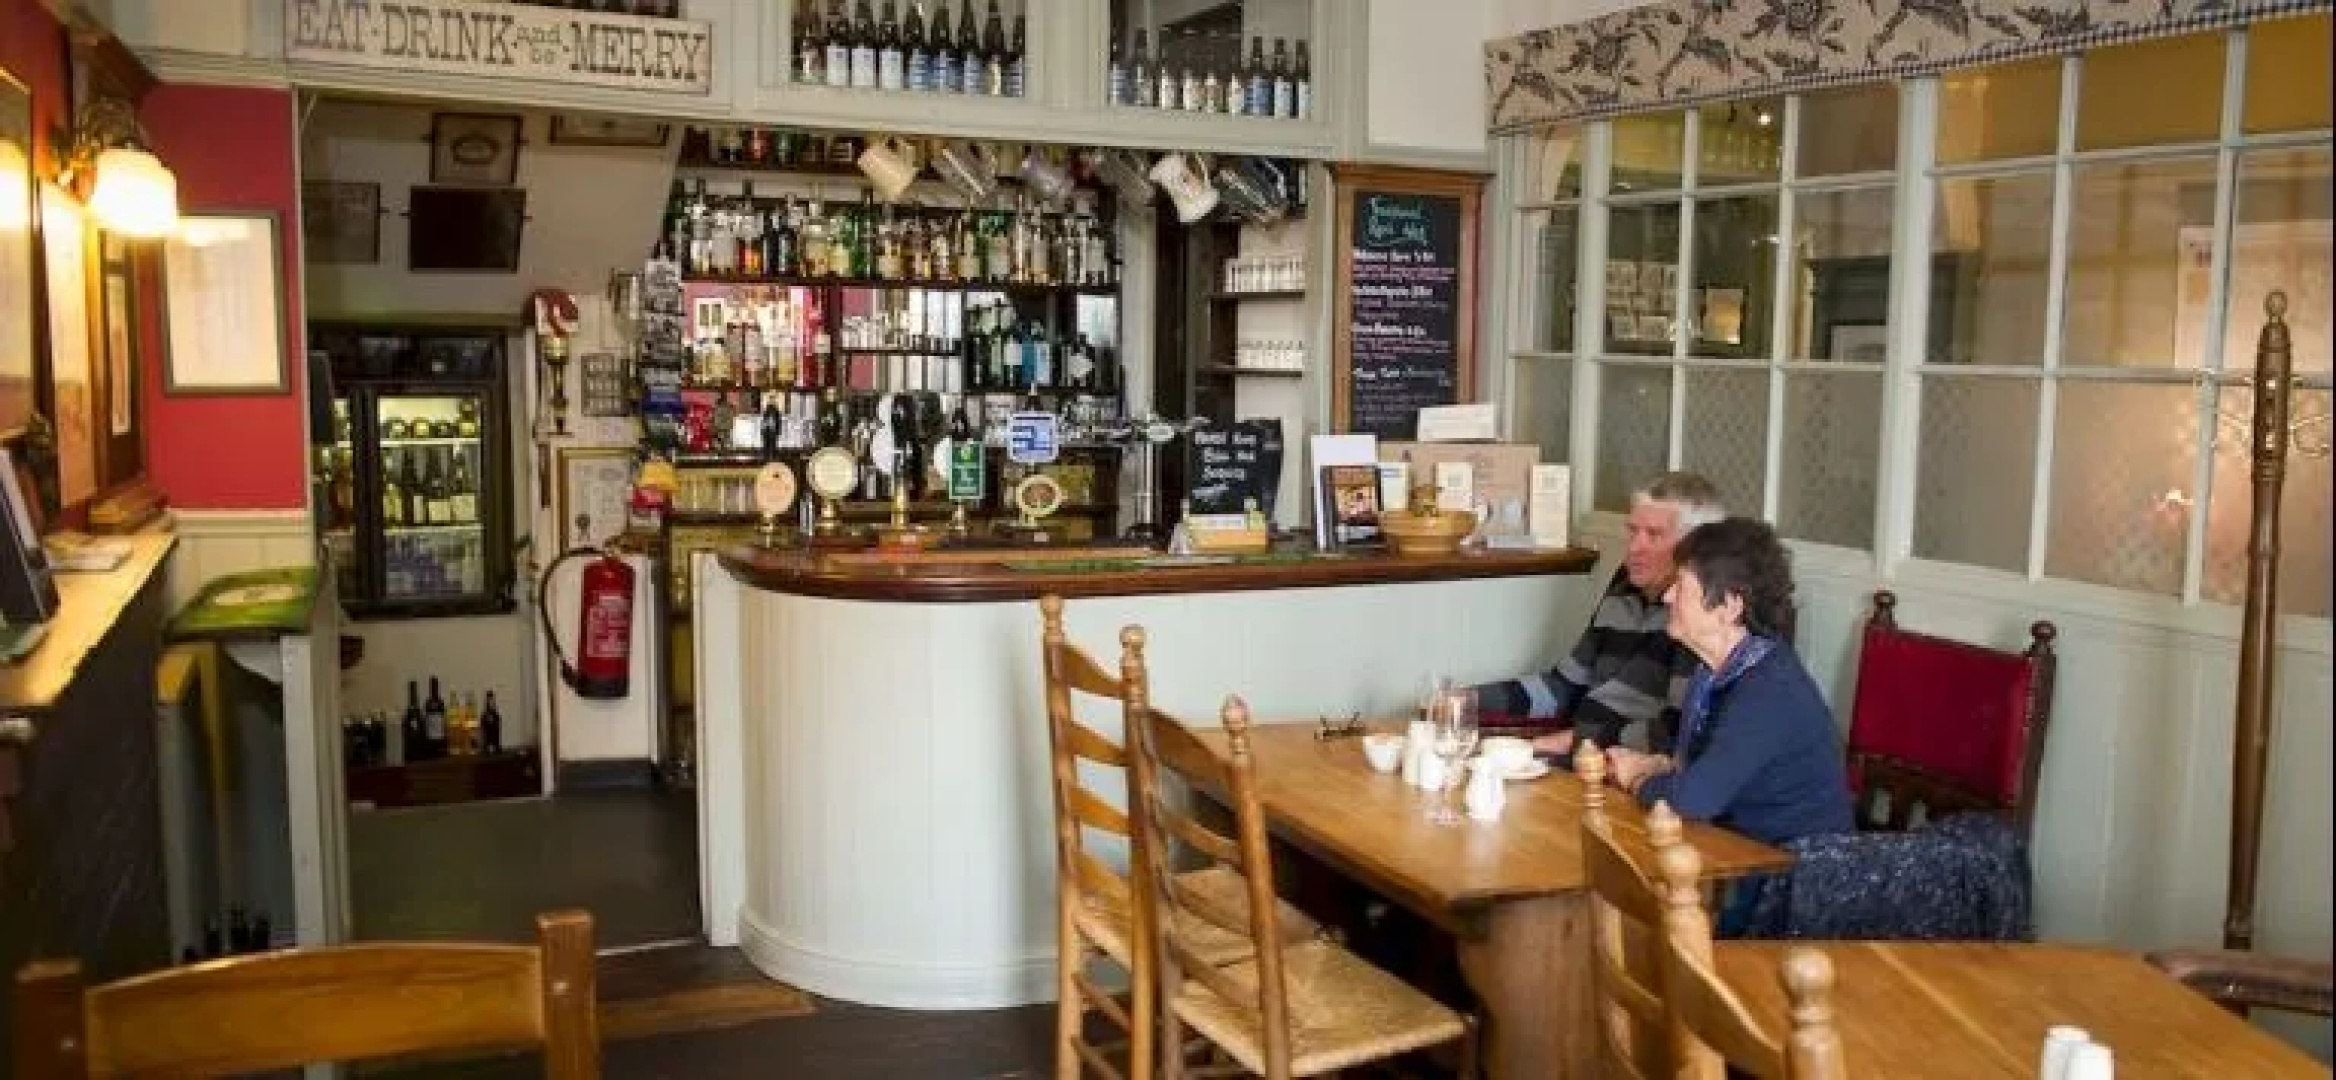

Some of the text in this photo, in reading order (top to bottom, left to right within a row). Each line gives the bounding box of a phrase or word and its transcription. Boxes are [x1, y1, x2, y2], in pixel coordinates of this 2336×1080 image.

[292, 0, 370, 51] EAT
[381, 3, 514, 64] DRINK
[569, 20, 706, 82] MERRY
